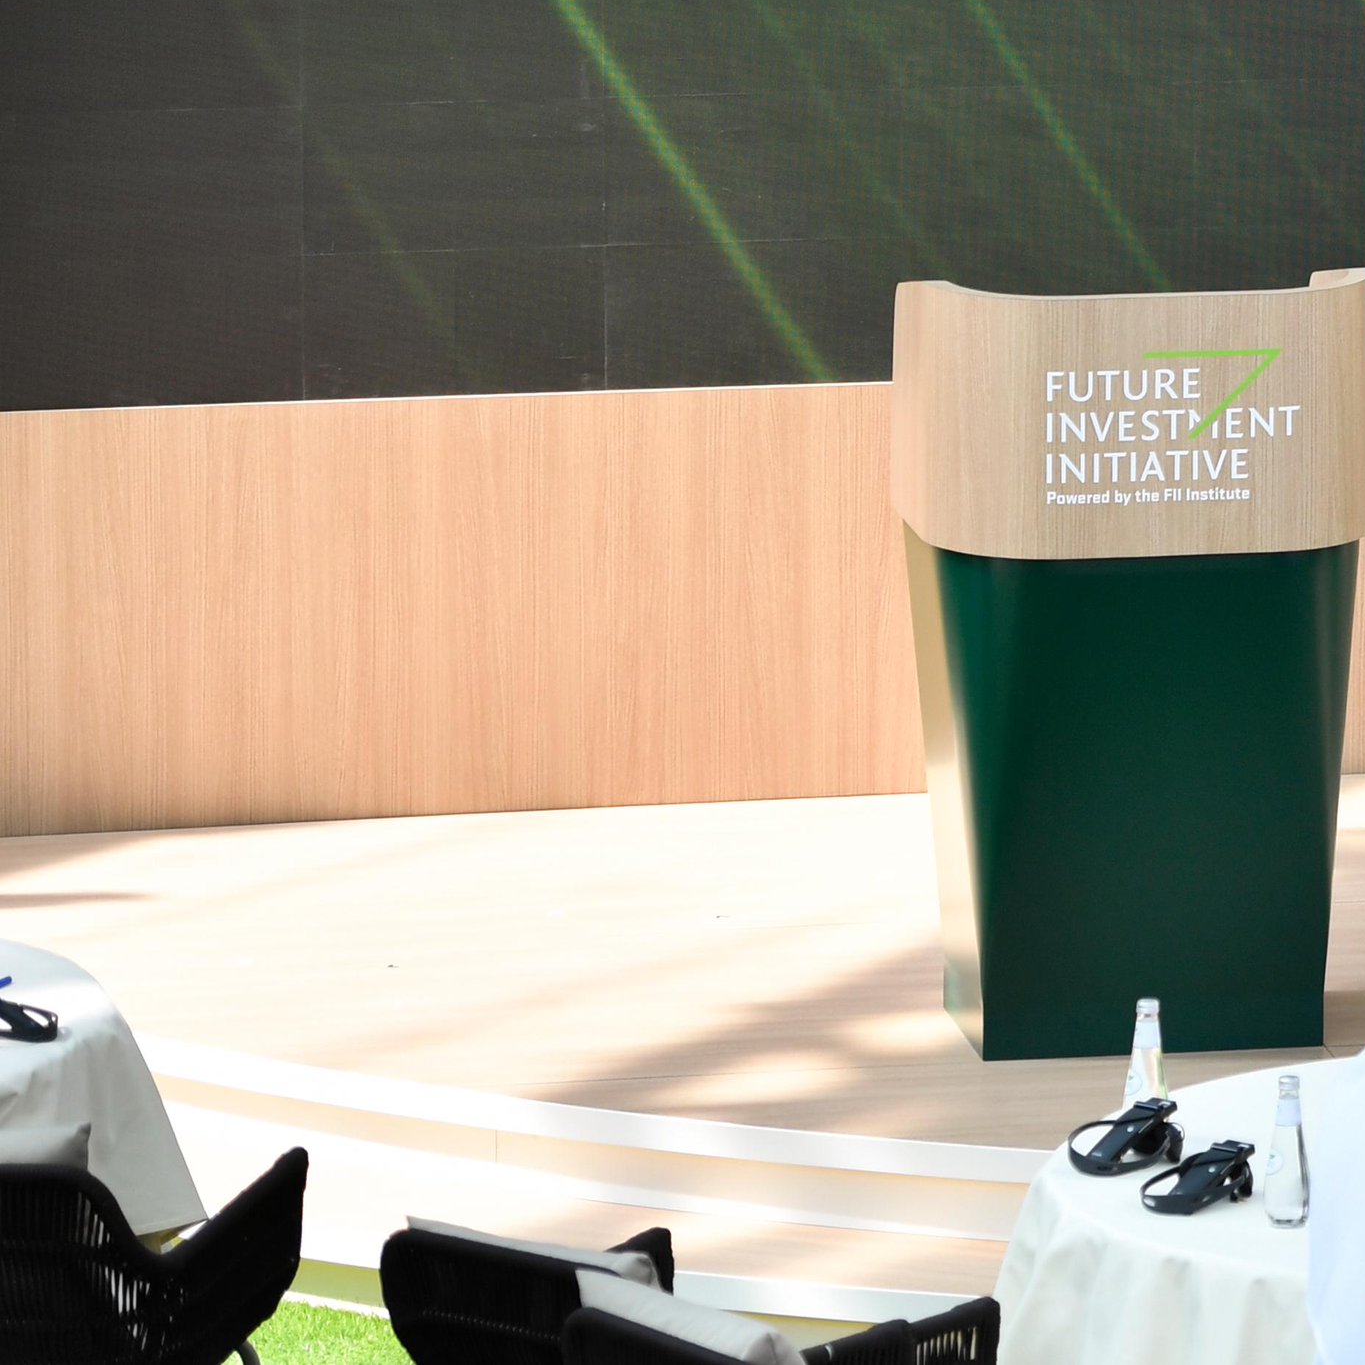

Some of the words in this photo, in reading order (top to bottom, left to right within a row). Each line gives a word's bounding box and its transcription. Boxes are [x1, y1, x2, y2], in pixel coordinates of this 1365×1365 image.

[1046, 368, 1201, 402] FUTURE
[1046, 405, 1300, 443] INVESTMENT
[1046, 448, 1249, 484] INITIATIVE
[1046, 490, 1110, 505] Powered
[1114, 490, 1131, 506] by
[1135, 489, 1159, 503] the
[1163, 488, 1182, 502] FII
[1186, 487, 1250, 502] Institute
